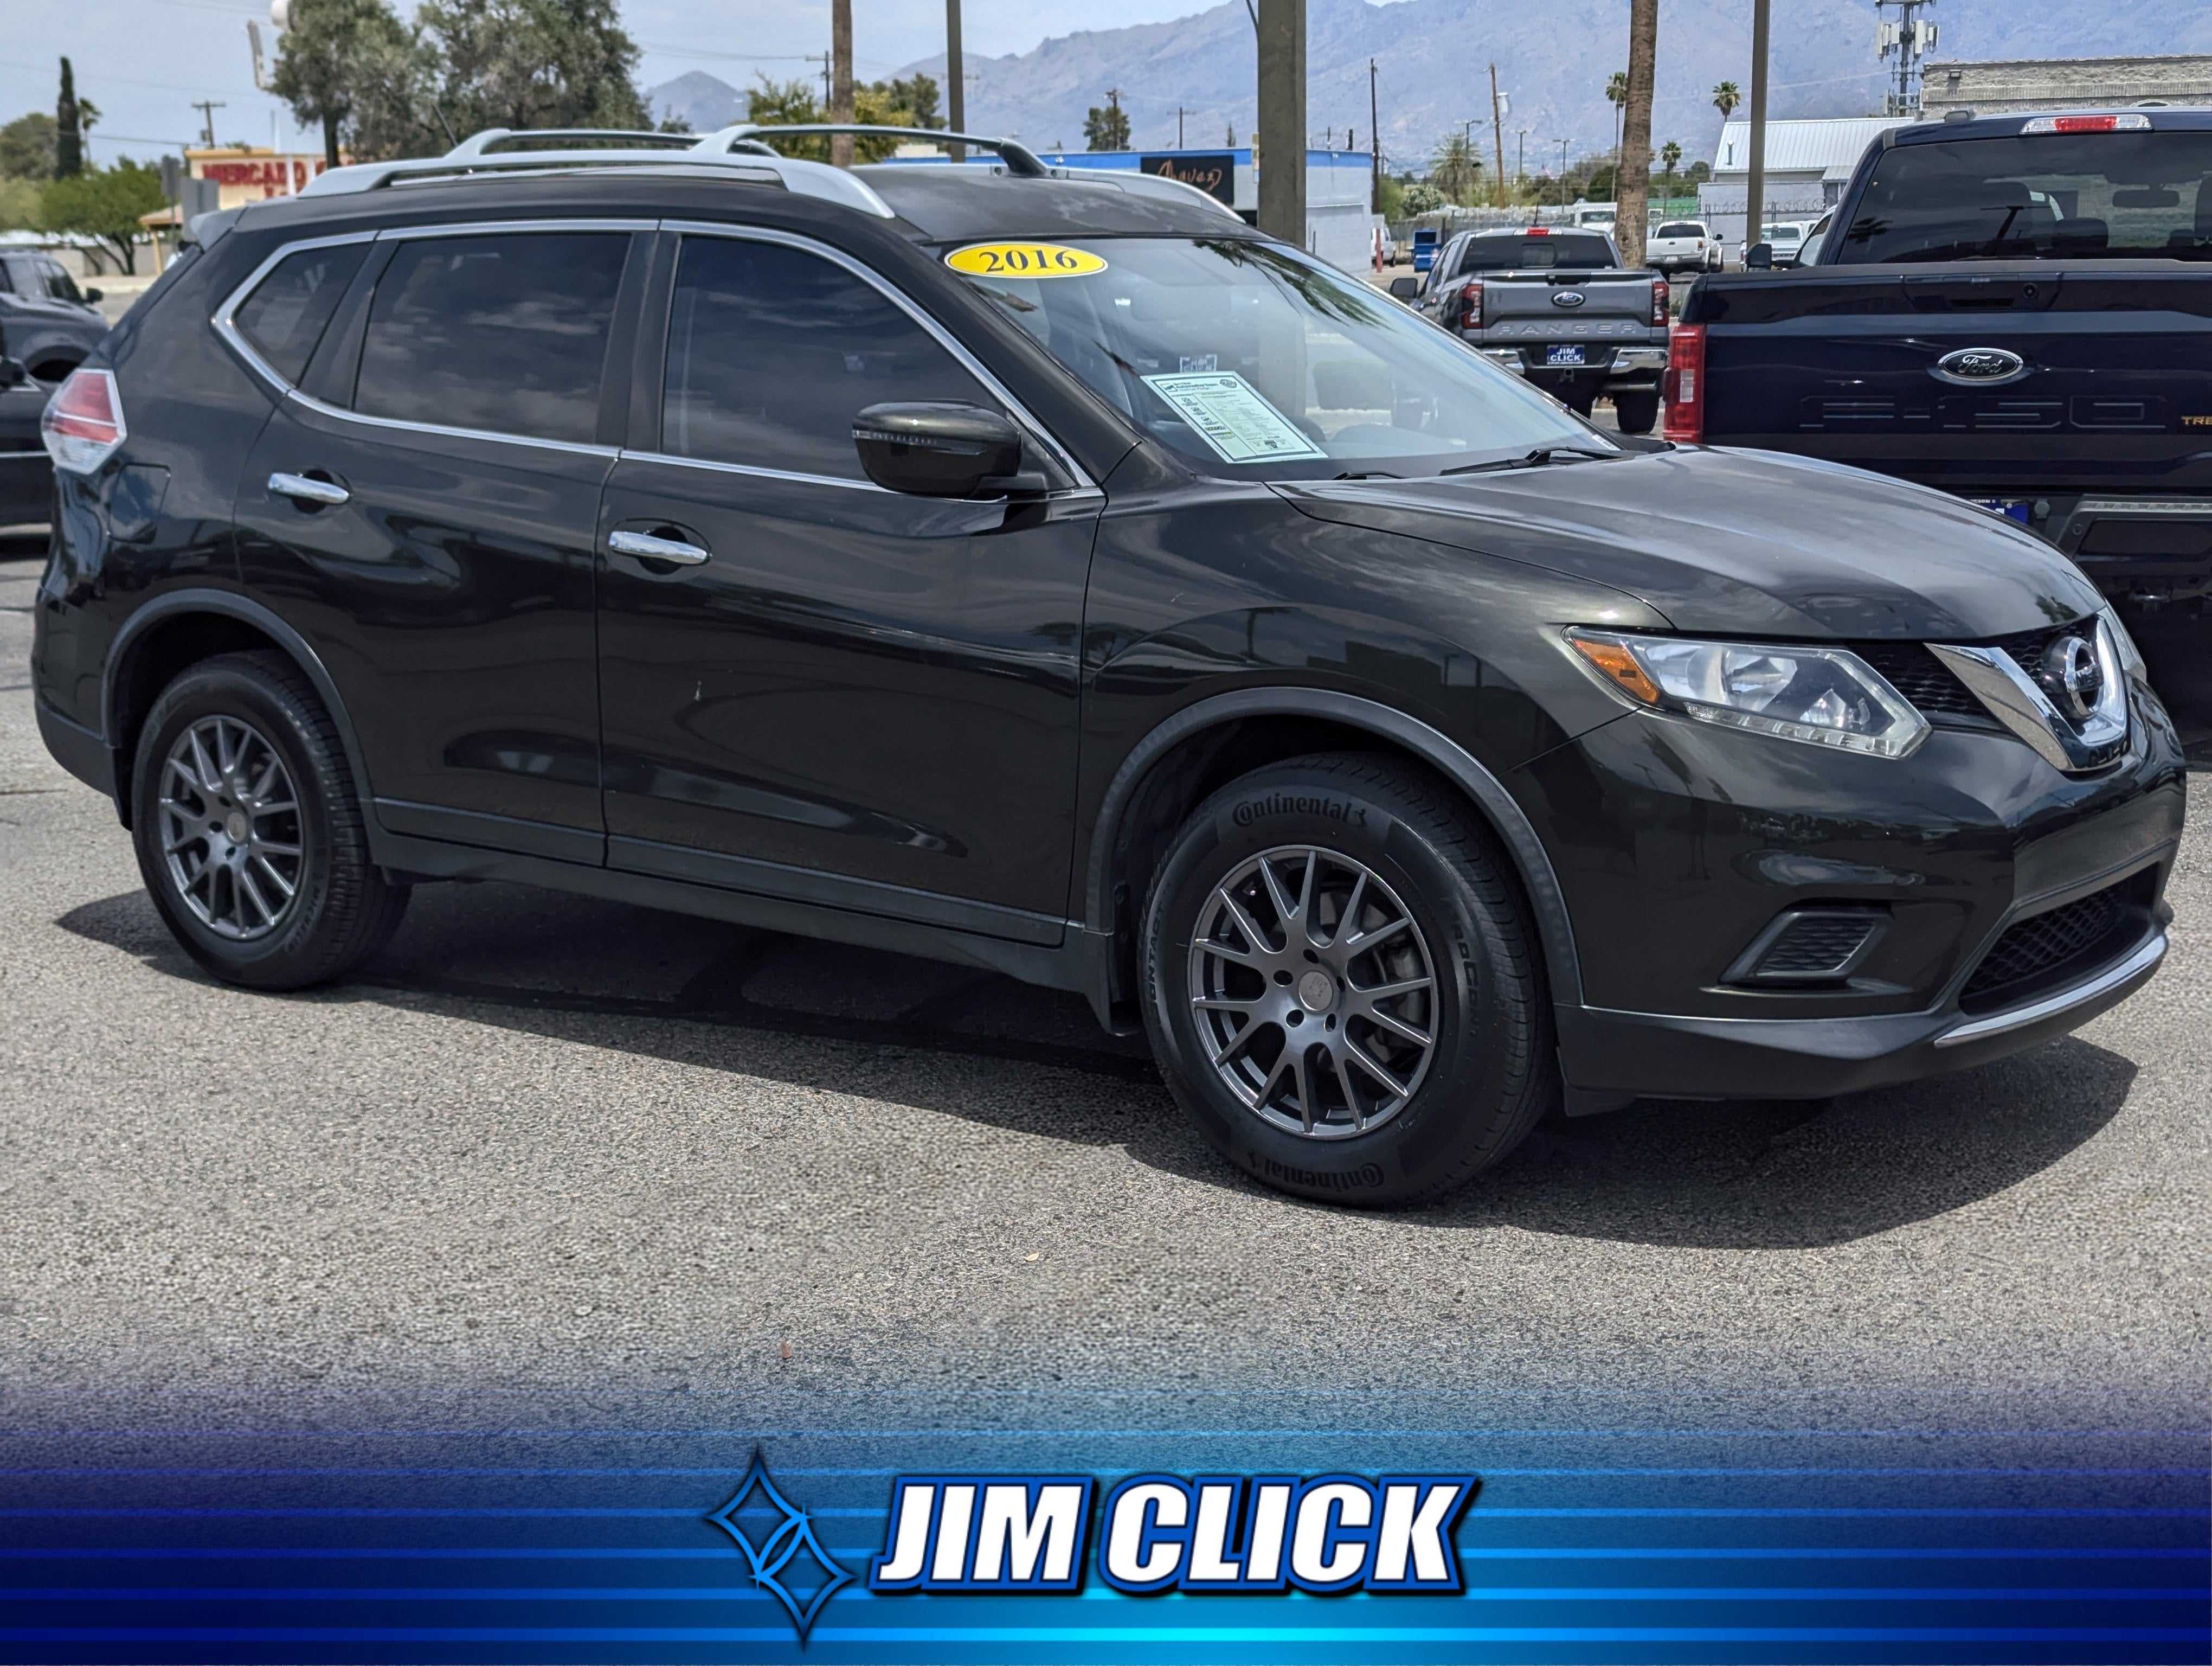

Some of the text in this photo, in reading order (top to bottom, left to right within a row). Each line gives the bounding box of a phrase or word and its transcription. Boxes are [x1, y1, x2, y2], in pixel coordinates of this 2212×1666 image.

[979, 249, 1078, 272] 2016
[1499, 325, 1636, 335] RANGER
[1958, 355, 2003, 373] Ford
[1799, 395, 2168, 428] F-150
[1232, 793, 1352, 826] Continental
